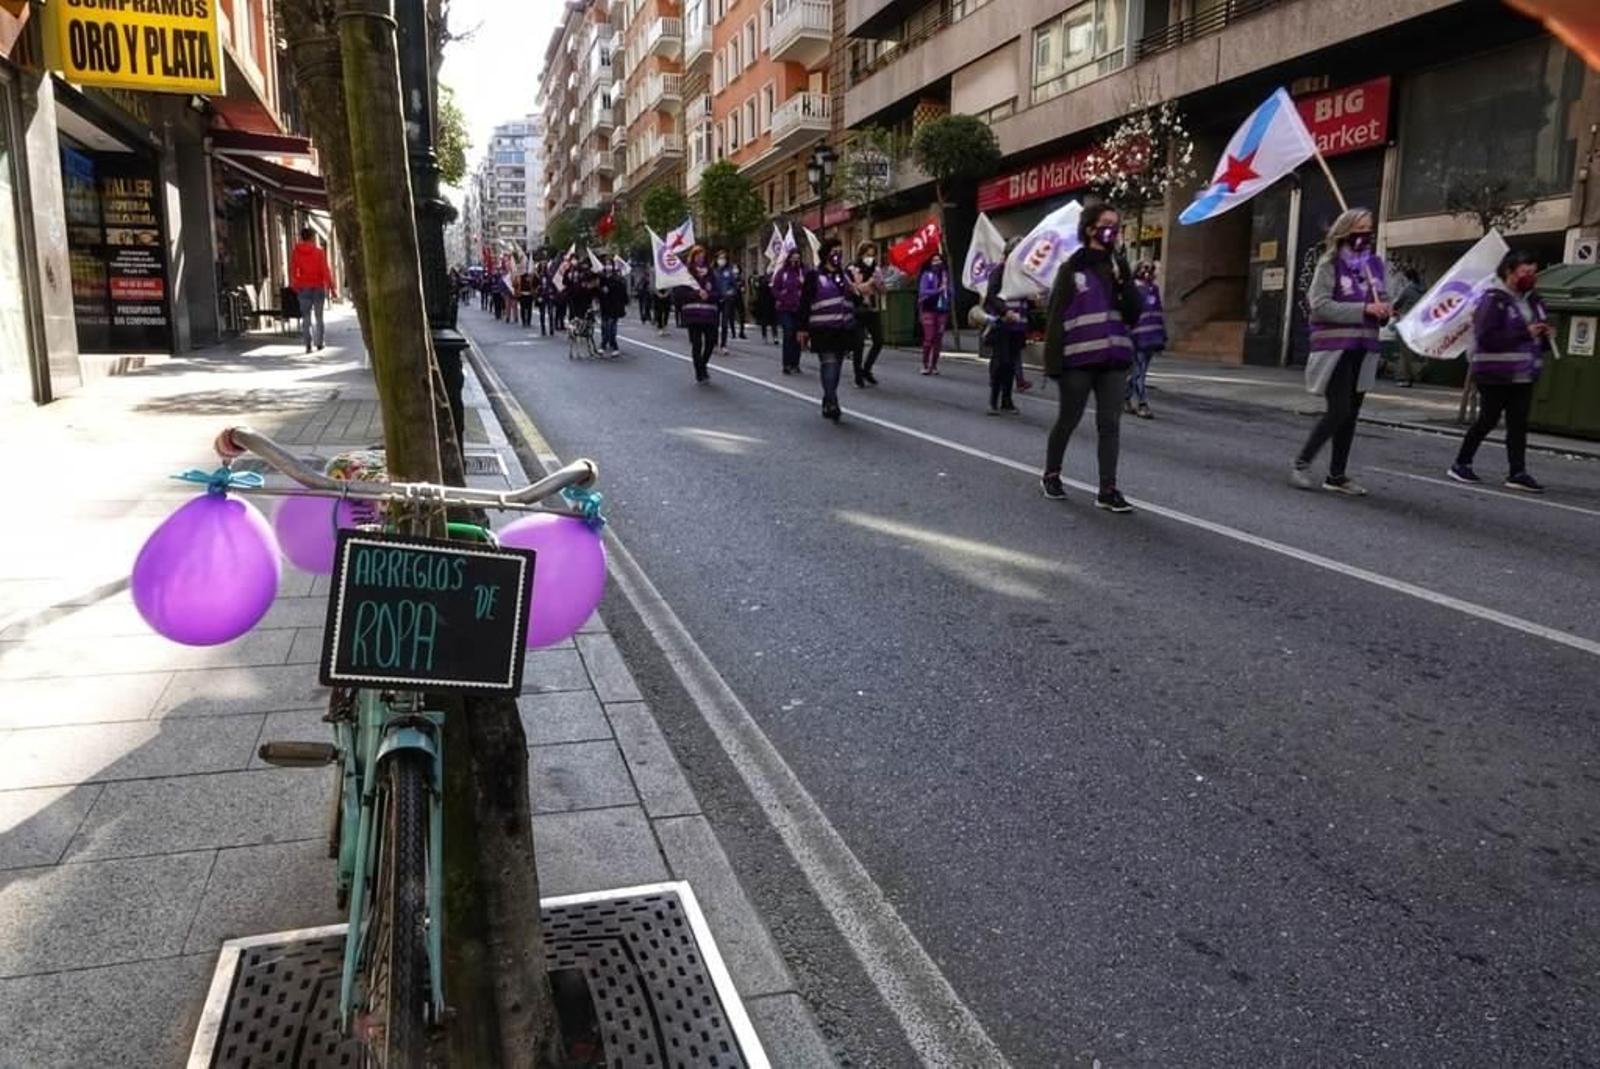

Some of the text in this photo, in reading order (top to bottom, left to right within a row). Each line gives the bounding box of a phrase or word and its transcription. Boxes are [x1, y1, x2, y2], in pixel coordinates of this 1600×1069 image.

[69, 18, 215, 80] ORO Y PLATA
[1315, 88, 1364, 123] BIG
[1009, 157, 1091, 199] BIG Marke
[355, 549, 501, 621] ARREGLOS DE
[351, 599, 438, 672] ROPA
